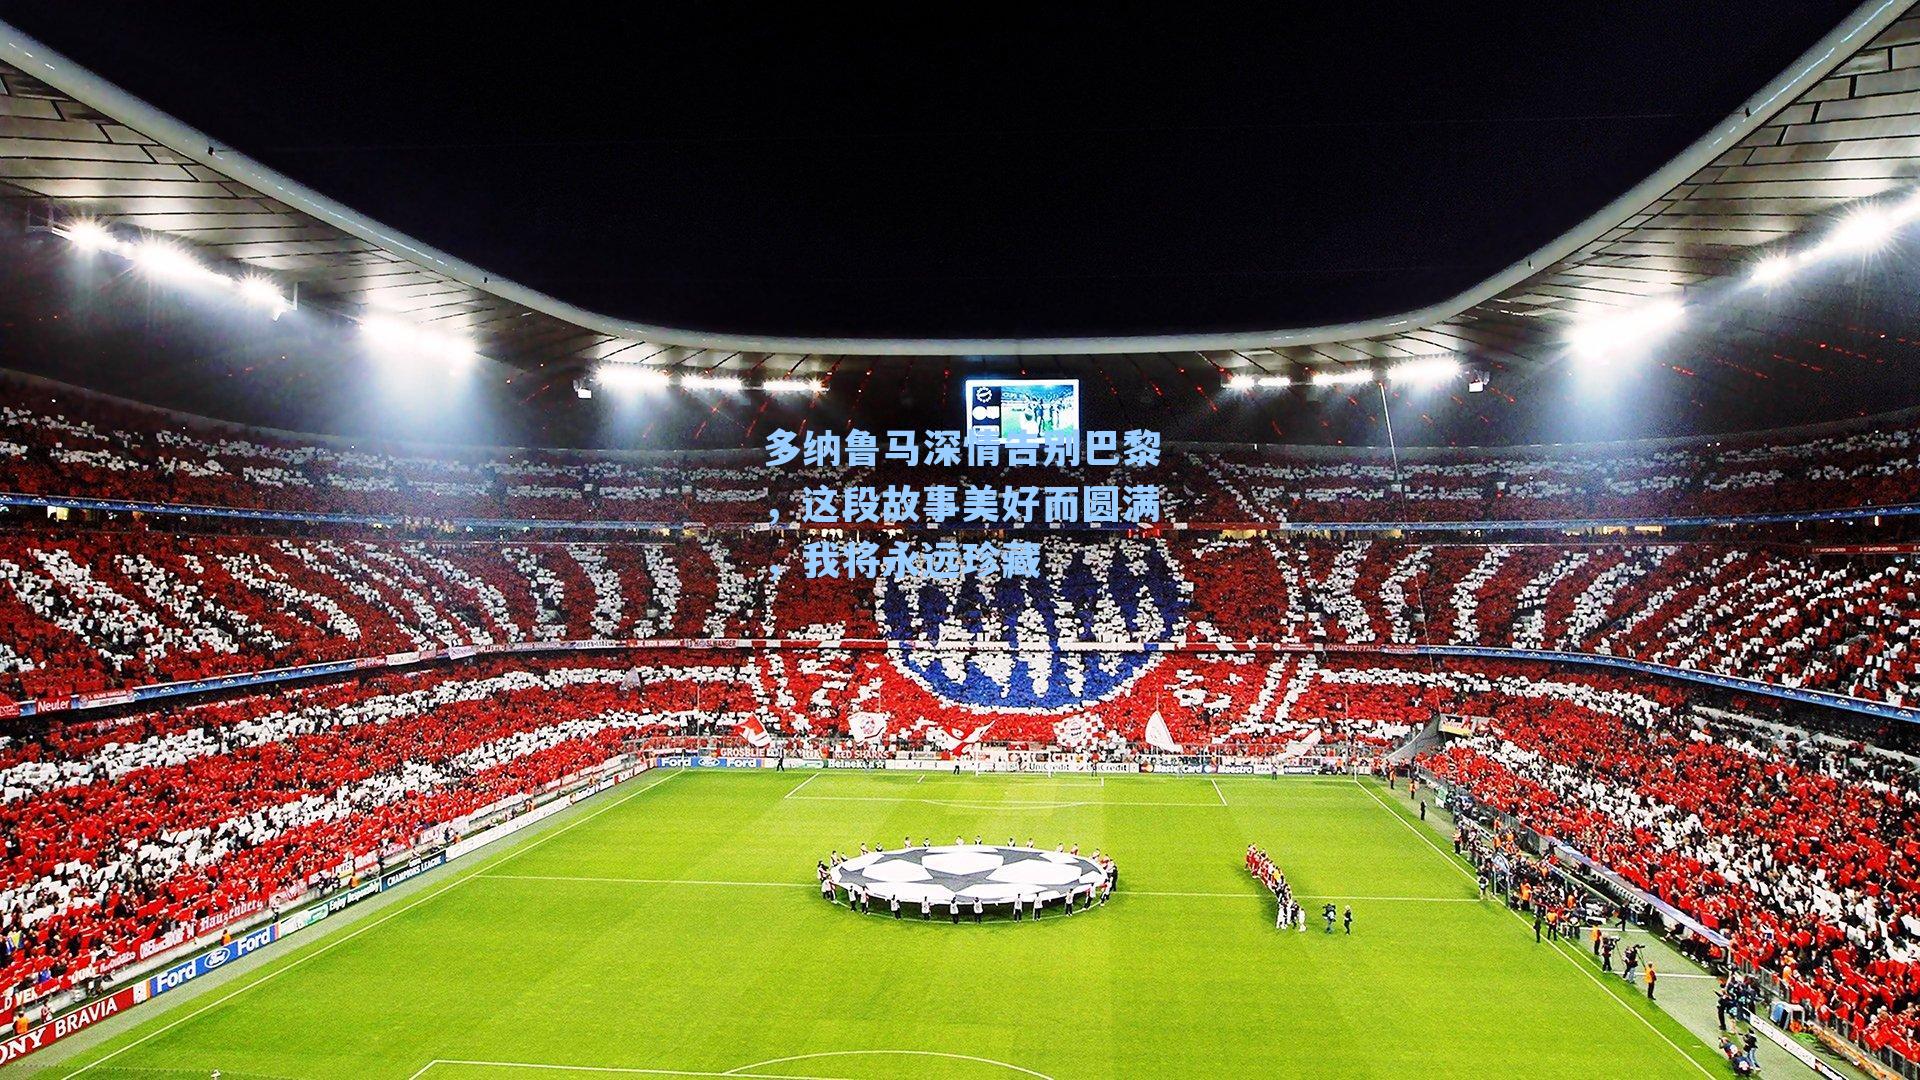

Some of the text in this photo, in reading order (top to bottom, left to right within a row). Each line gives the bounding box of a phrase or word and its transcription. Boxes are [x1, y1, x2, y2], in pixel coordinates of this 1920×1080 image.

[37, 699, 70, 713] Neuler
[661, 757, 691, 767] Ford
[726, 758, 757, 767] Ford
[1086, 763, 1128, 772] UiCredit
[387, 864, 421, 886] CHAMPIONS
[156, 960, 197, 993] Ford
[237, 927, 271, 956] Ford
[55, 997, 118, 1038] BRAVIA
